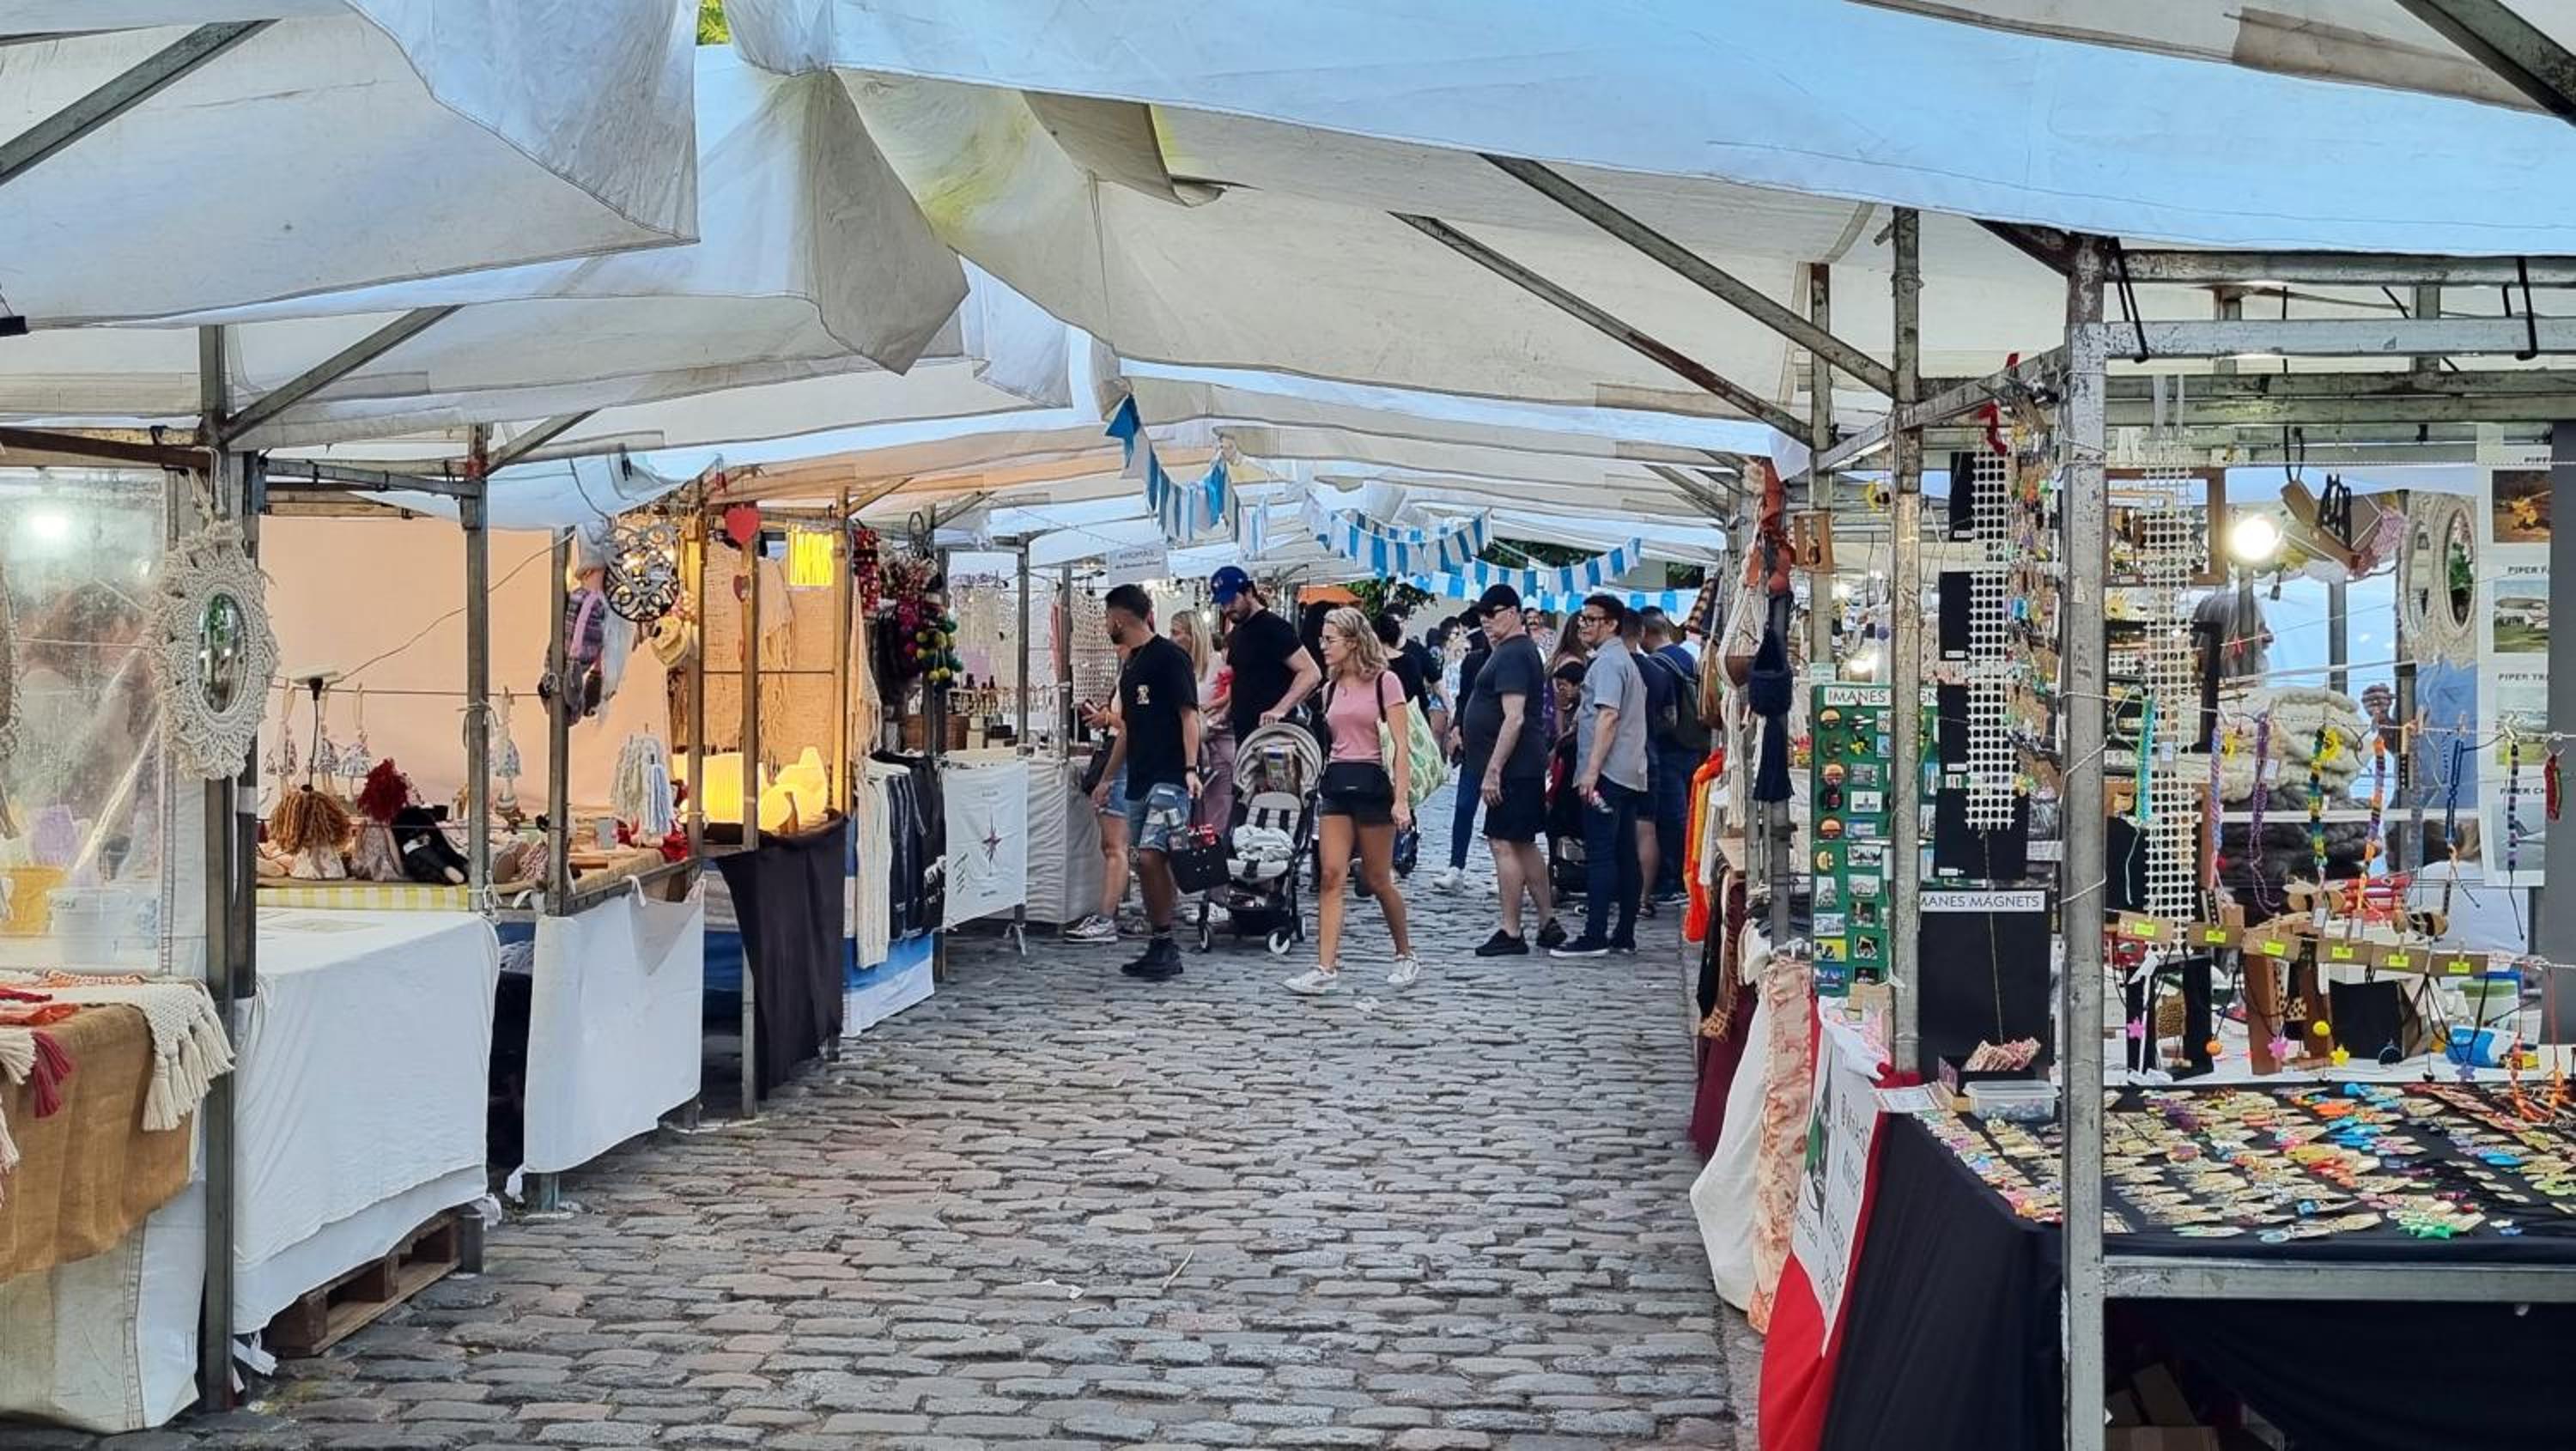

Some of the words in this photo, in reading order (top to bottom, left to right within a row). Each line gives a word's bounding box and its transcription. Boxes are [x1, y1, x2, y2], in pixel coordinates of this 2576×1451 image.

[2507, 566, 2538, 574] PIPER
[1829, 689, 1886, 702] IMANES
[1920, 895, 1965, 908] MANES
[1969, 895, 2039, 908] MAGNETS
